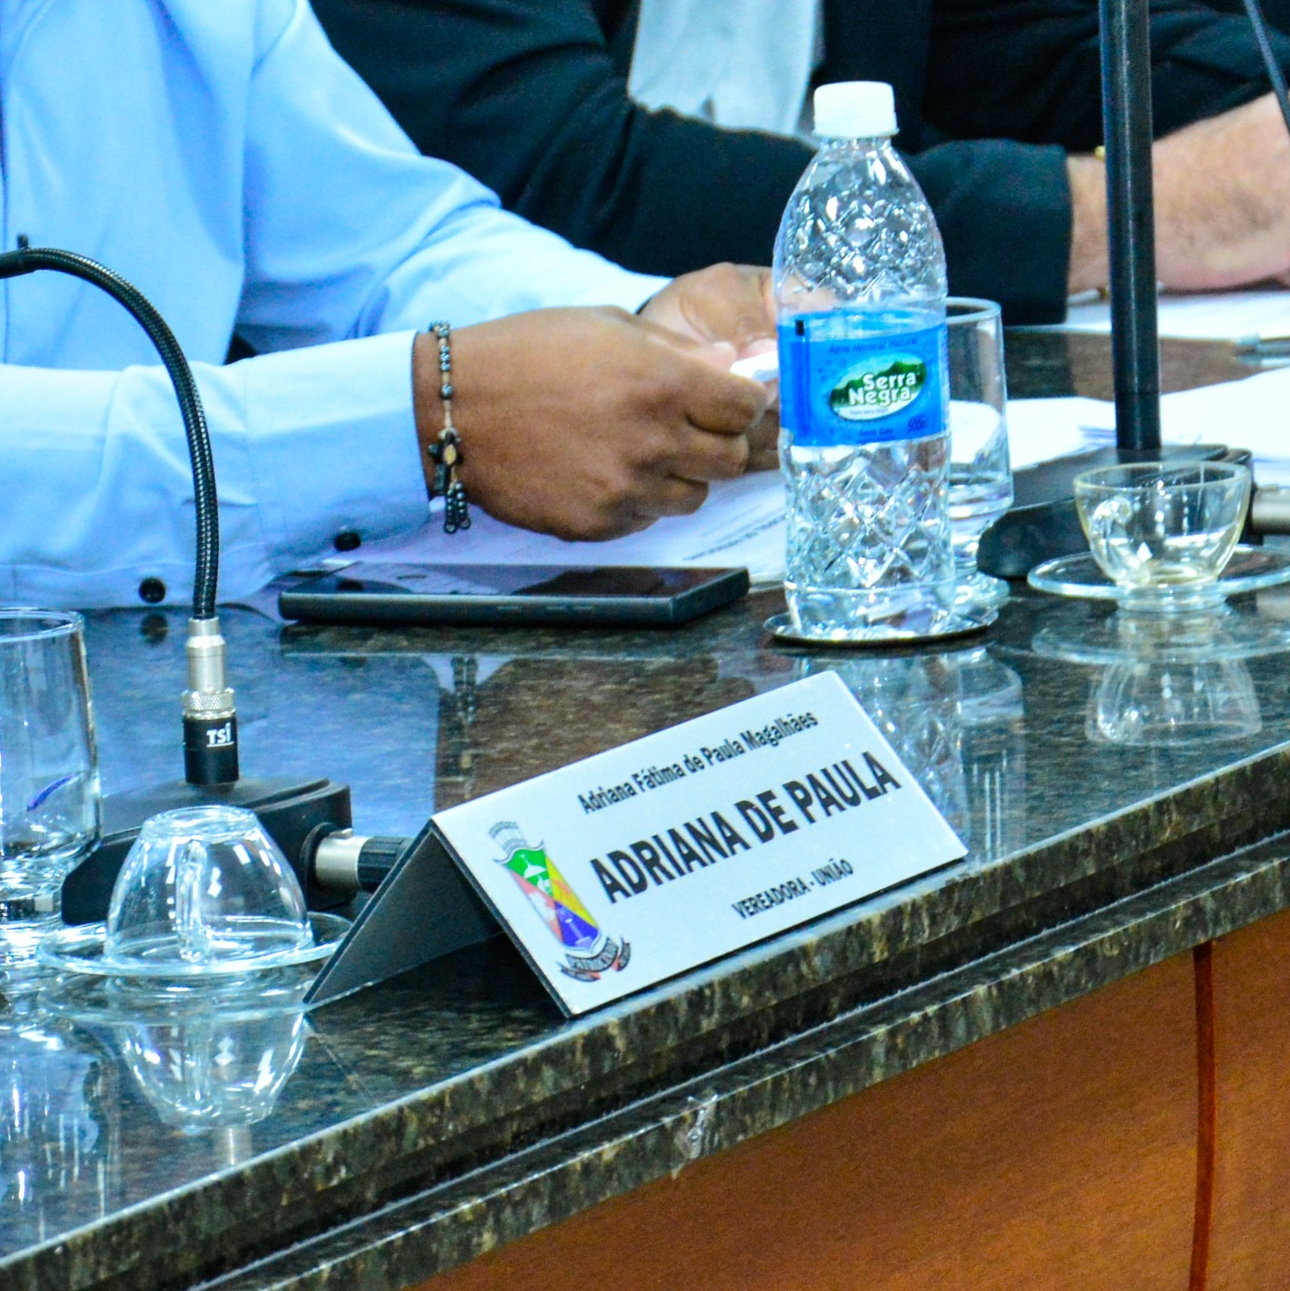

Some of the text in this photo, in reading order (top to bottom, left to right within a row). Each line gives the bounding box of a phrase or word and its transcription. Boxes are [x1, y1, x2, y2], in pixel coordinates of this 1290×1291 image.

[848, 386, 912, 407] Negra
[862, 372, 916, 390] Serra
[577, 712, 819, 814] Adriana Fátima de Paula Magalhães
[590, 751, 902, 904] ADRIANA DE PAULA
[731, 876, 811, 919] VEREADORA
[812, 858, 855, 886] UNIÃO
